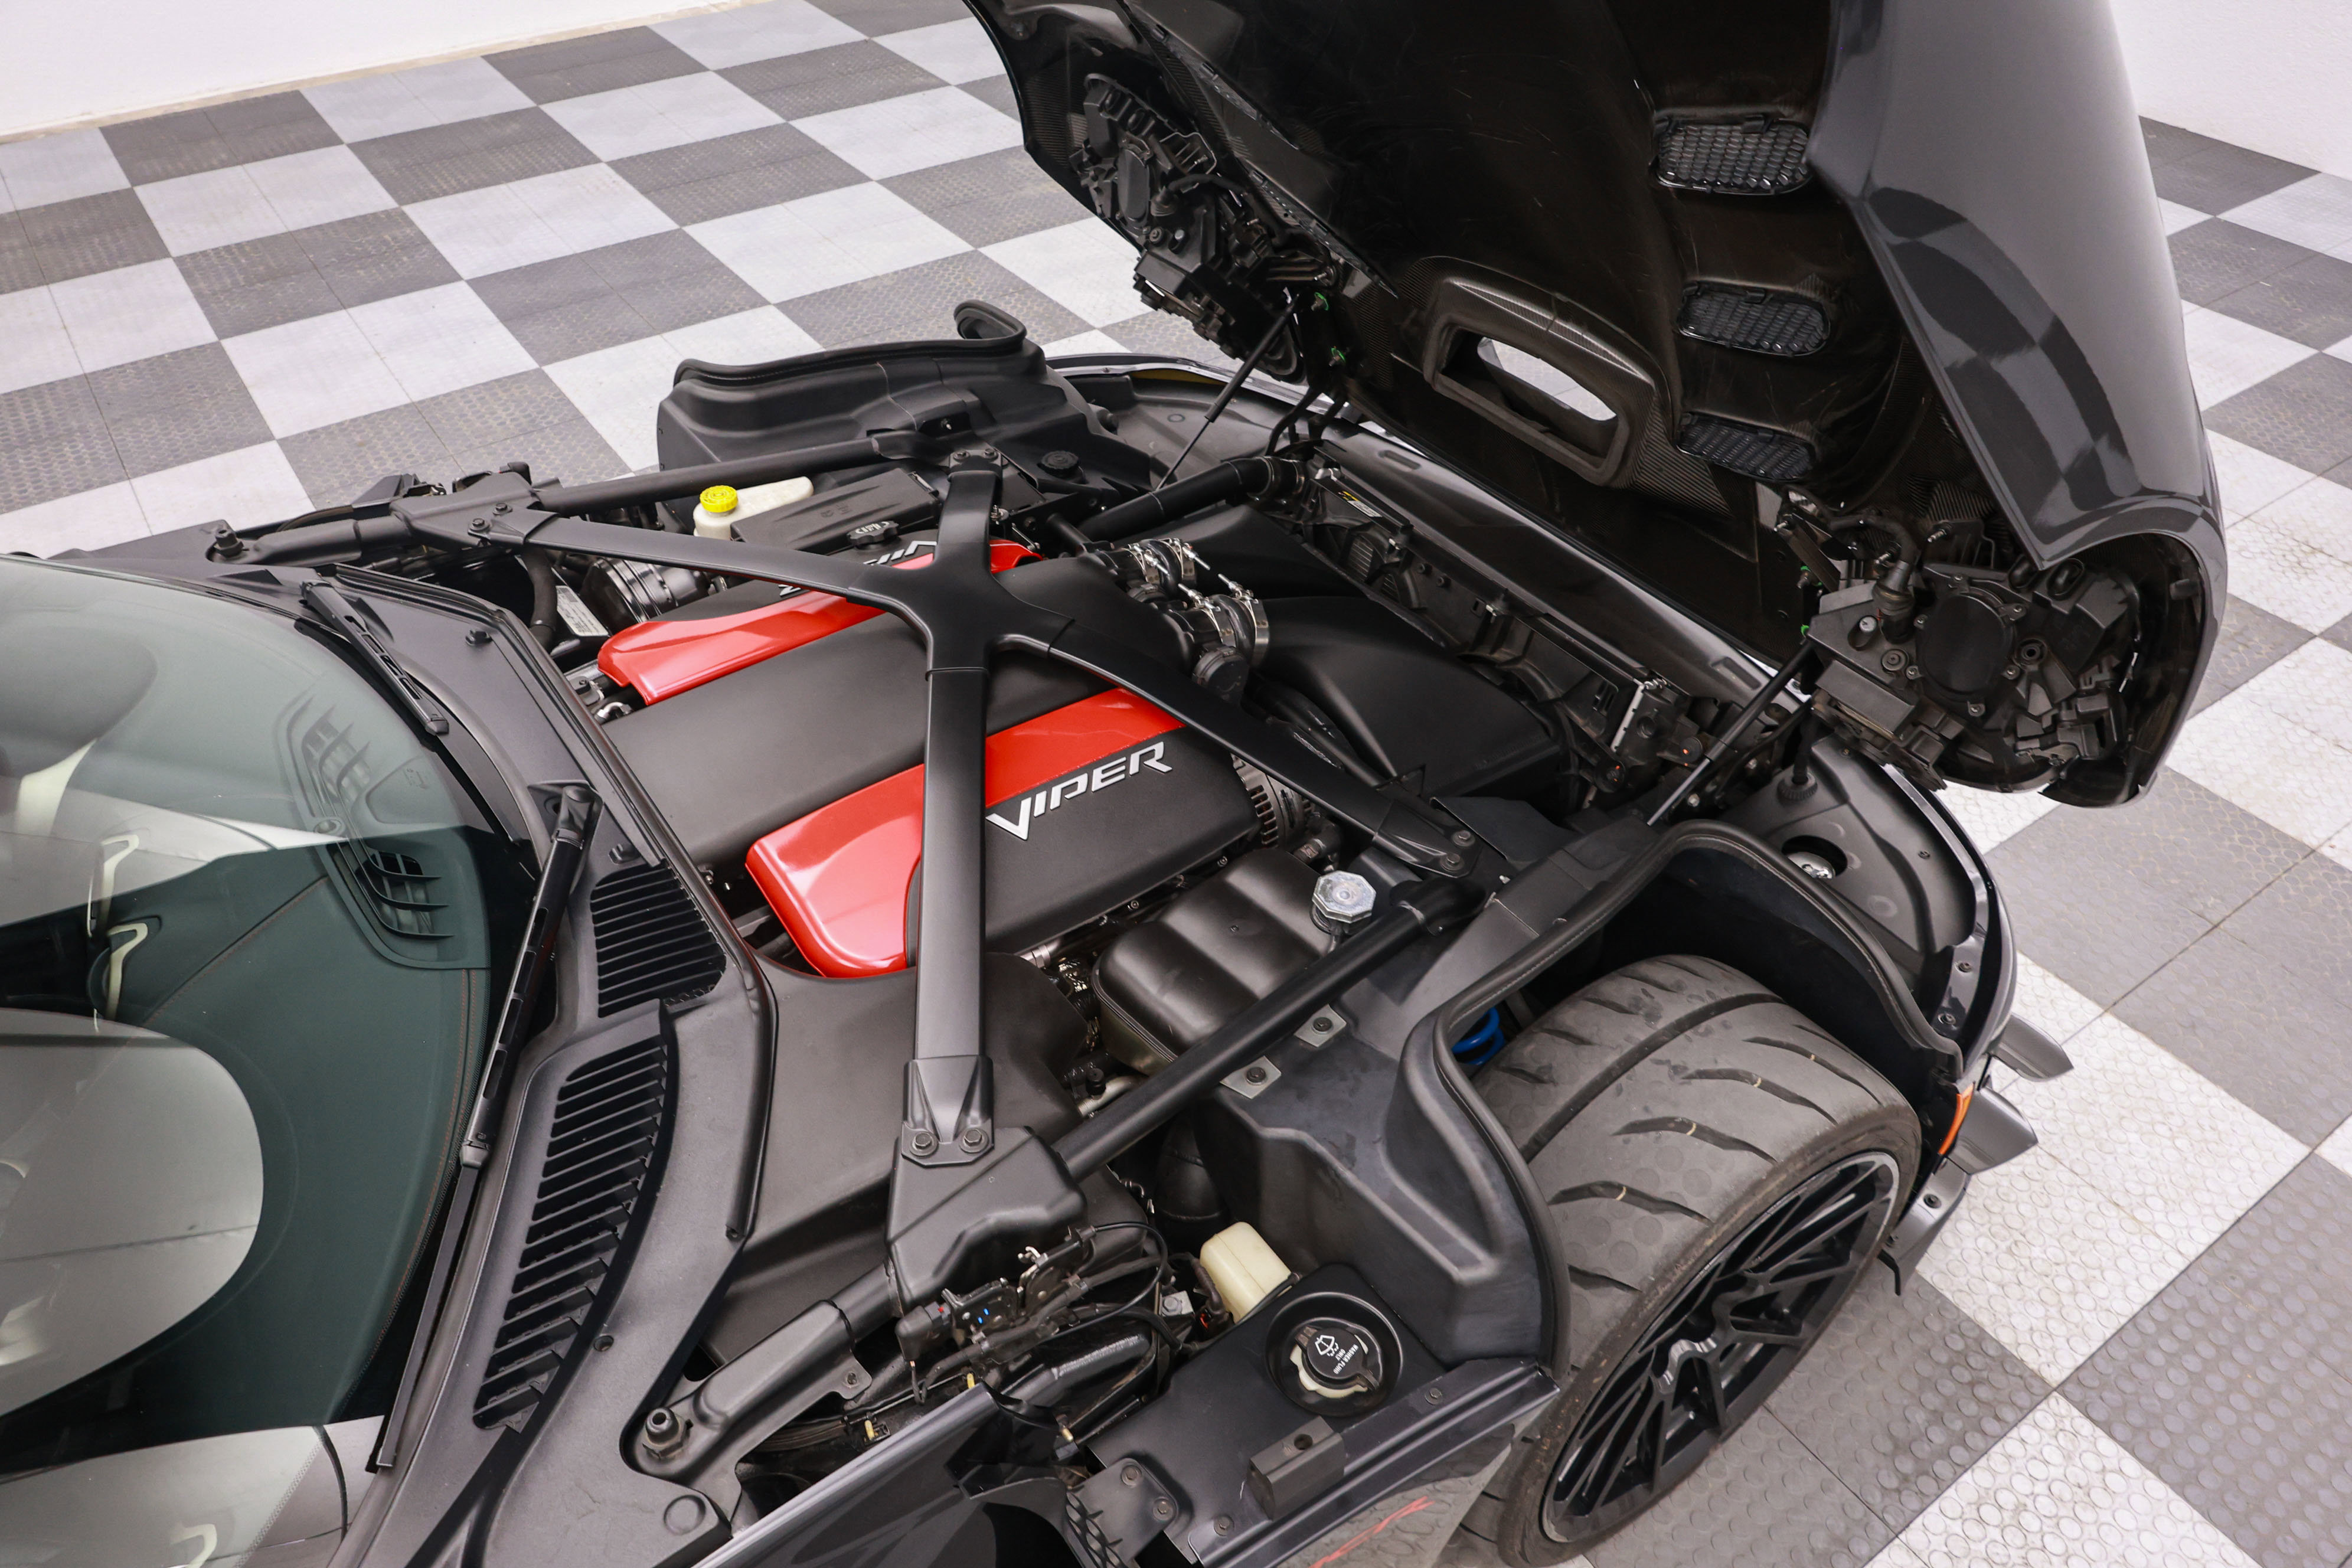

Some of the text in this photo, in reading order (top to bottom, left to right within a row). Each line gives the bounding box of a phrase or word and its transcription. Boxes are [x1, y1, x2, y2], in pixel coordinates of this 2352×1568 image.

[986, 741, 1173, 841] VIPER
[1333, 1344, 1358, 1374] WASHER FLUID
[1335, 1348, 1346, 1361] ONLY
